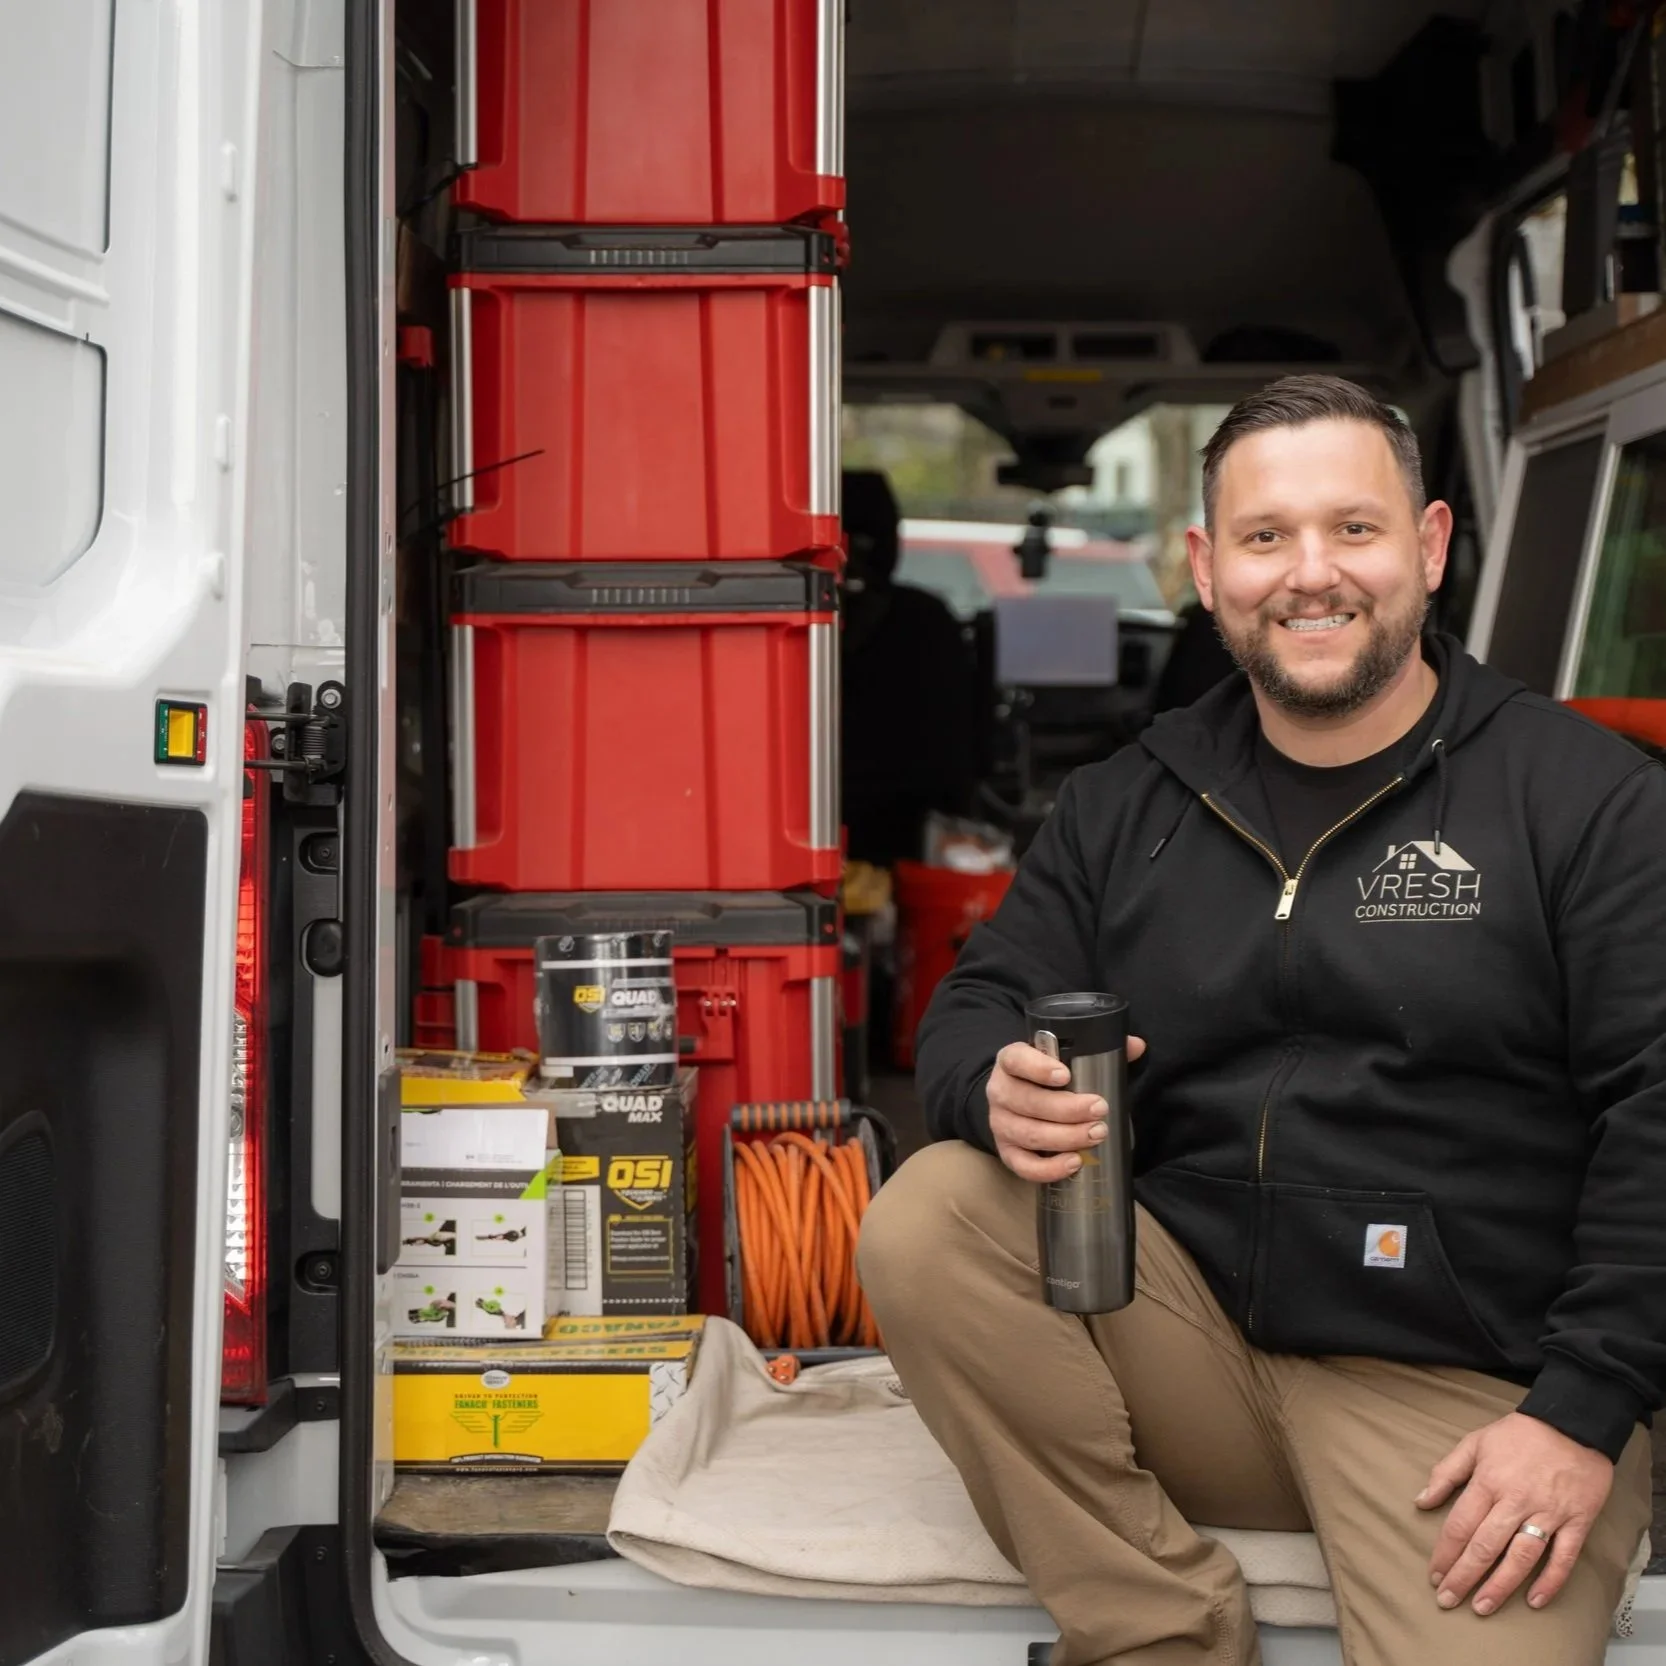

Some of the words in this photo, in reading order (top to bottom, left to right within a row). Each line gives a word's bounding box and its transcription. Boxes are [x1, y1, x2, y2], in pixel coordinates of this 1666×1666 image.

[1357, 873, 1481, 900] VRESH
[1355, 902, 1481, 918] CONSTRUCTION
[574, 986, 605, 1004] OSI
[611, 990, 657, 1006] QUAD
[602, 1095, 663, 1112] QUAD
[628, 1112, 663, 1123] MAX
[607, 1160, 673, 1190] OSI
[1046, 1277, 1080, 1290] contigo
[455, 1399, 487, 1409] FANACO
[492, 1399, 538, 1409] FASTENERS
